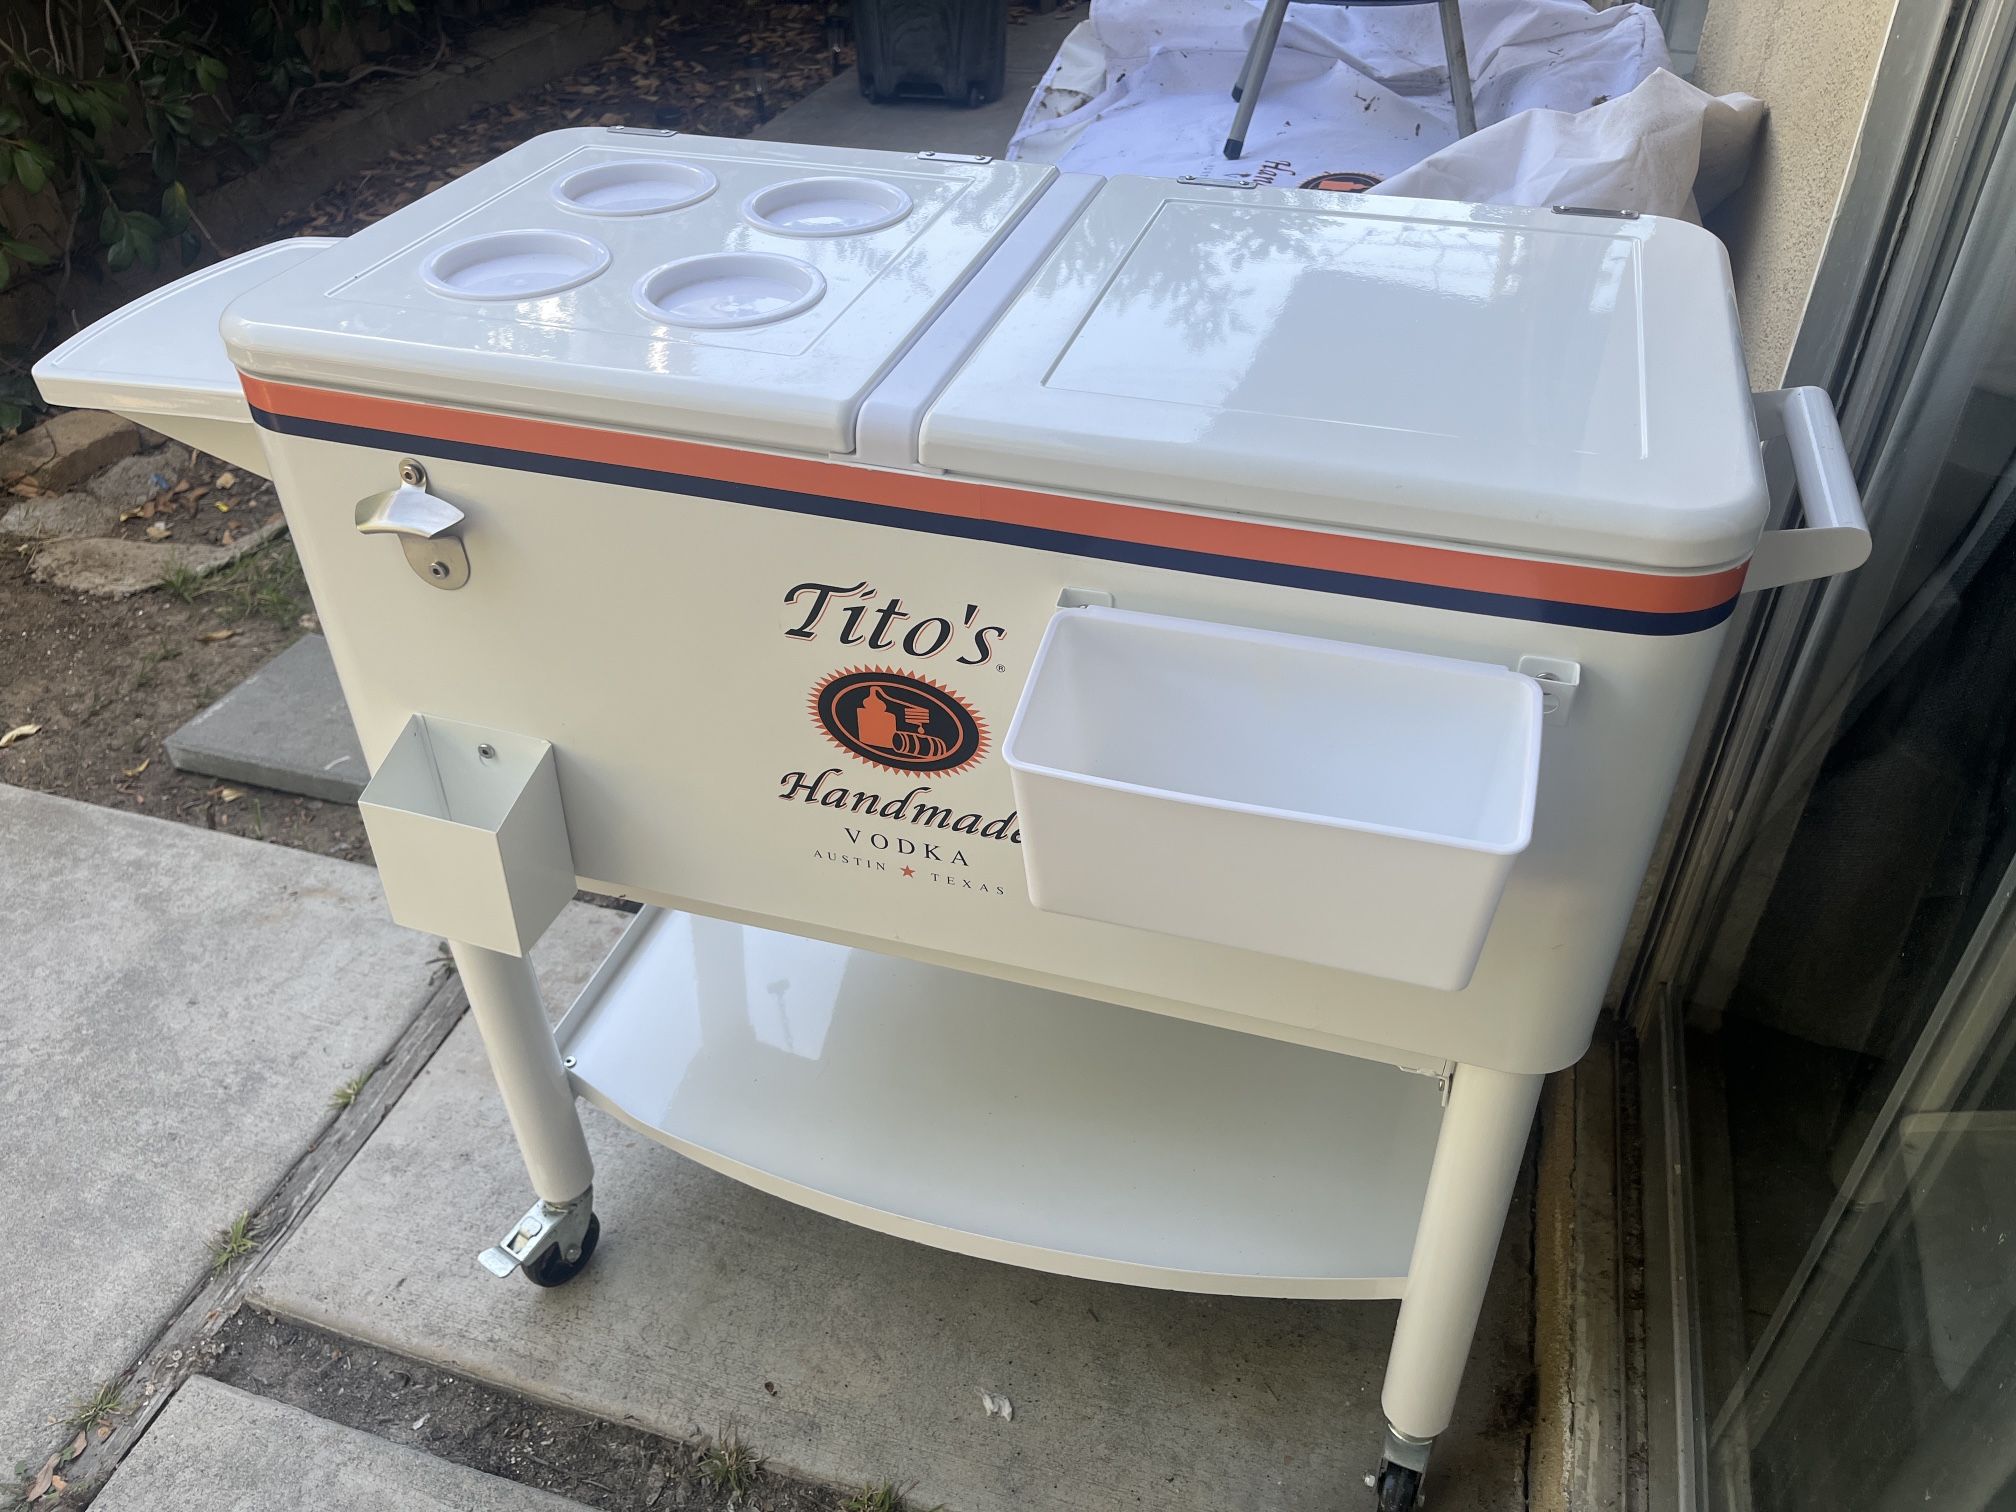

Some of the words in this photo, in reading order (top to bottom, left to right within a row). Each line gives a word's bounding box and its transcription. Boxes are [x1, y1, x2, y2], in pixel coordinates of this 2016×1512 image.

[783, 581, 1007, 666] Tito's
[844, 827, 969, 867] VODKA
[813, 849, 886, 871] AUSTIN
[930, 872, 1005, 895] TEXAS
